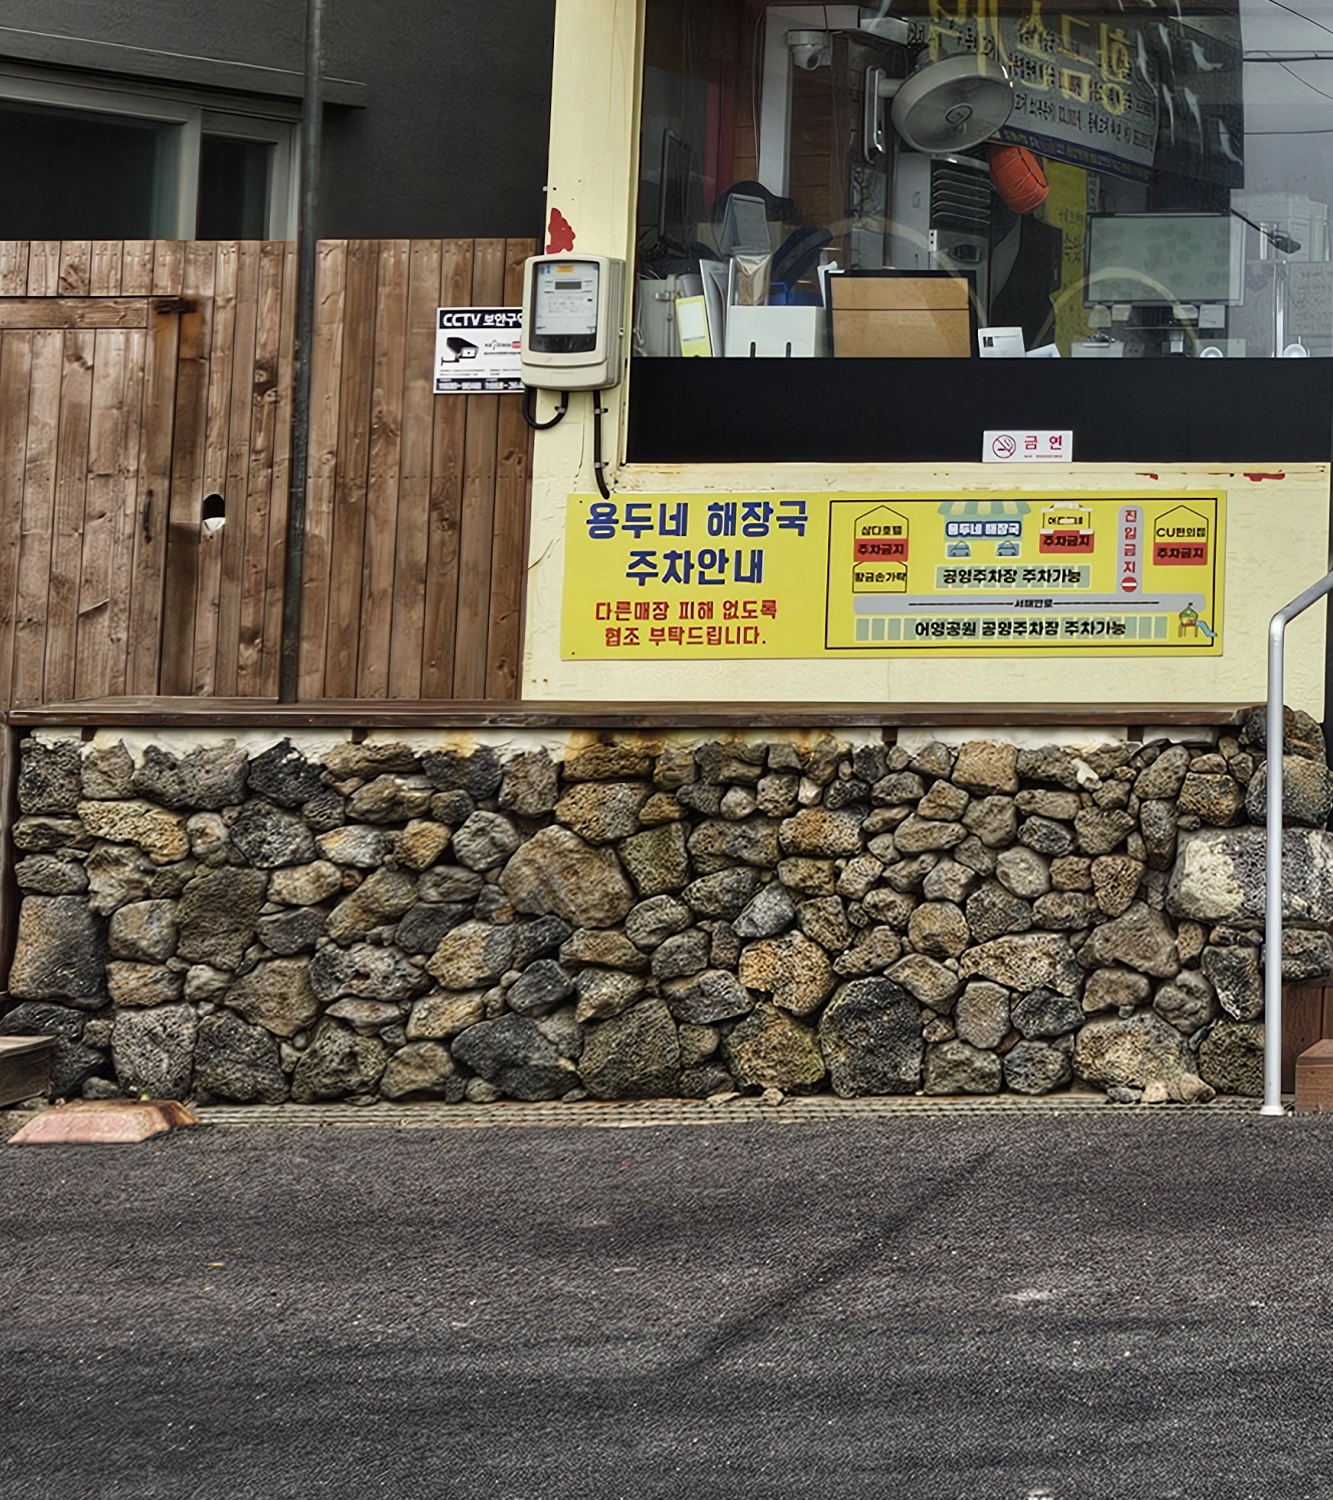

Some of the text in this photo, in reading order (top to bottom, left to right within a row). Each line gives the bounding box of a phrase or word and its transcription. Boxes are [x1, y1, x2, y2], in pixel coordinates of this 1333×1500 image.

[443, 314, 481, 326] CCTV
[586, 500, 808, 539] 용두네 해장국
[1043, 535, 1090, 547] 주차금지
[1123, 509, 1137, 574] 진입금지
[857, 543, 904, 556] 주차금지
[1157, 547, 1204, 560] 주차금지
[625, 548, 764, 586] 주차안내
[943, 569, 1081, 584] 공영주차장 주차가능
[595, 599, 778, 621] 다른매장 피해 없도록
[605, 625, 767, 647] 협조 부탁드립니다.
[915, 621, 1125, 637] 어영공원 공영주차장 주차가능
